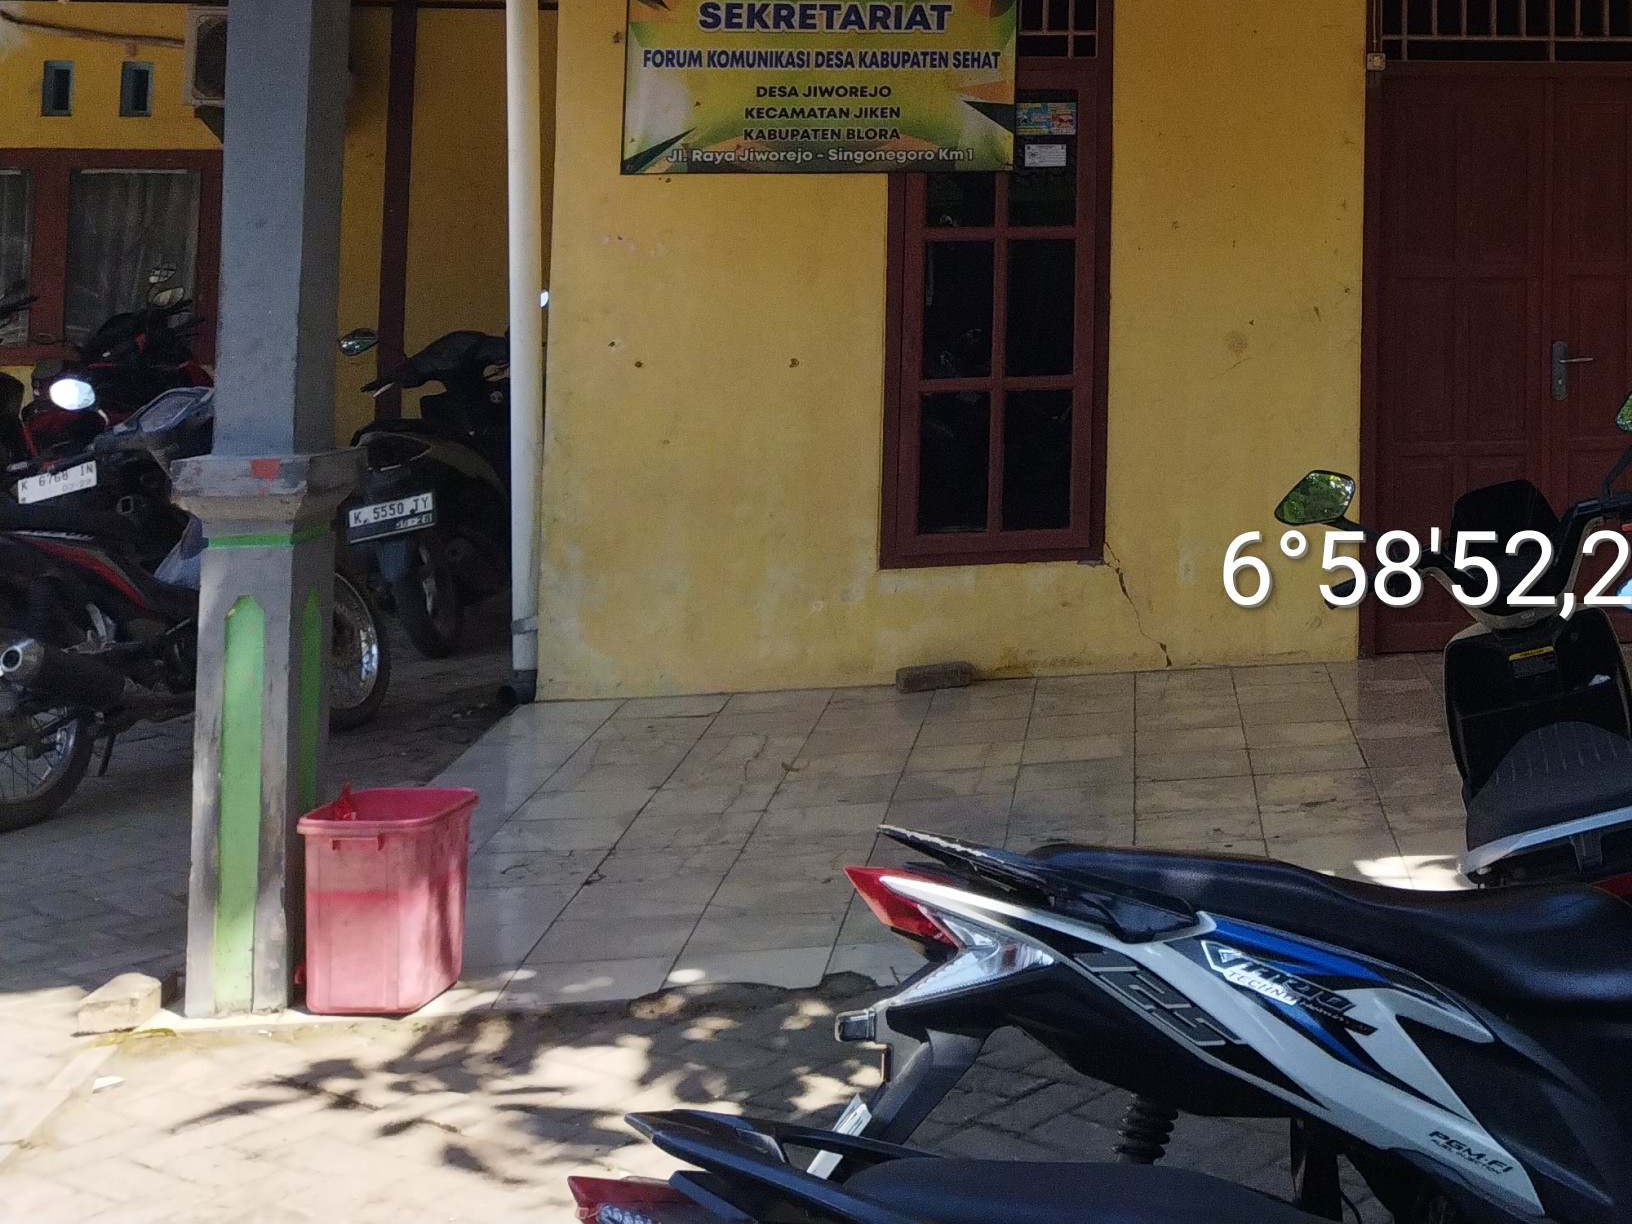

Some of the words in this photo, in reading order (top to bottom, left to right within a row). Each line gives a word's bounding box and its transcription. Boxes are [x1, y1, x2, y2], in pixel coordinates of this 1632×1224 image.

[698, 1, 952, 31] SEKRETARIAT
[643, 49, 702, 68] FORUM
[707, 50, 810, 68] KOMUNIKASI
[814, 51, 855, 68] DESA
[858, 51, 948, 68] KABUPATEN
[952, 52, 1001, 69] SEHAT
[755, 86, 799, 97] DESA
[802, 86, 892, 97] JIWOREJO
[745, 107, 850, 119] KECAMATAN
[853, 107, 901, 118] JIKEN
[743, 128, 842, 140] KABUPATEN
[846, 128, 901, 140] BLORA
[667, 149, 687, 162] Jl.
[692, 150, 735, 165] Raya
[739, 148, 813, 164] Jiworejo
[828, 147, 934, 164] Singonegoro
[938, 149, 964, 161] Km
[967, 149, 974, 161] 1
[21, 480, 29, 492] K
[353, 511, 362, 524] K
[373, 502, 404, 520] 5550
[412, 496, 429, 512] JY
